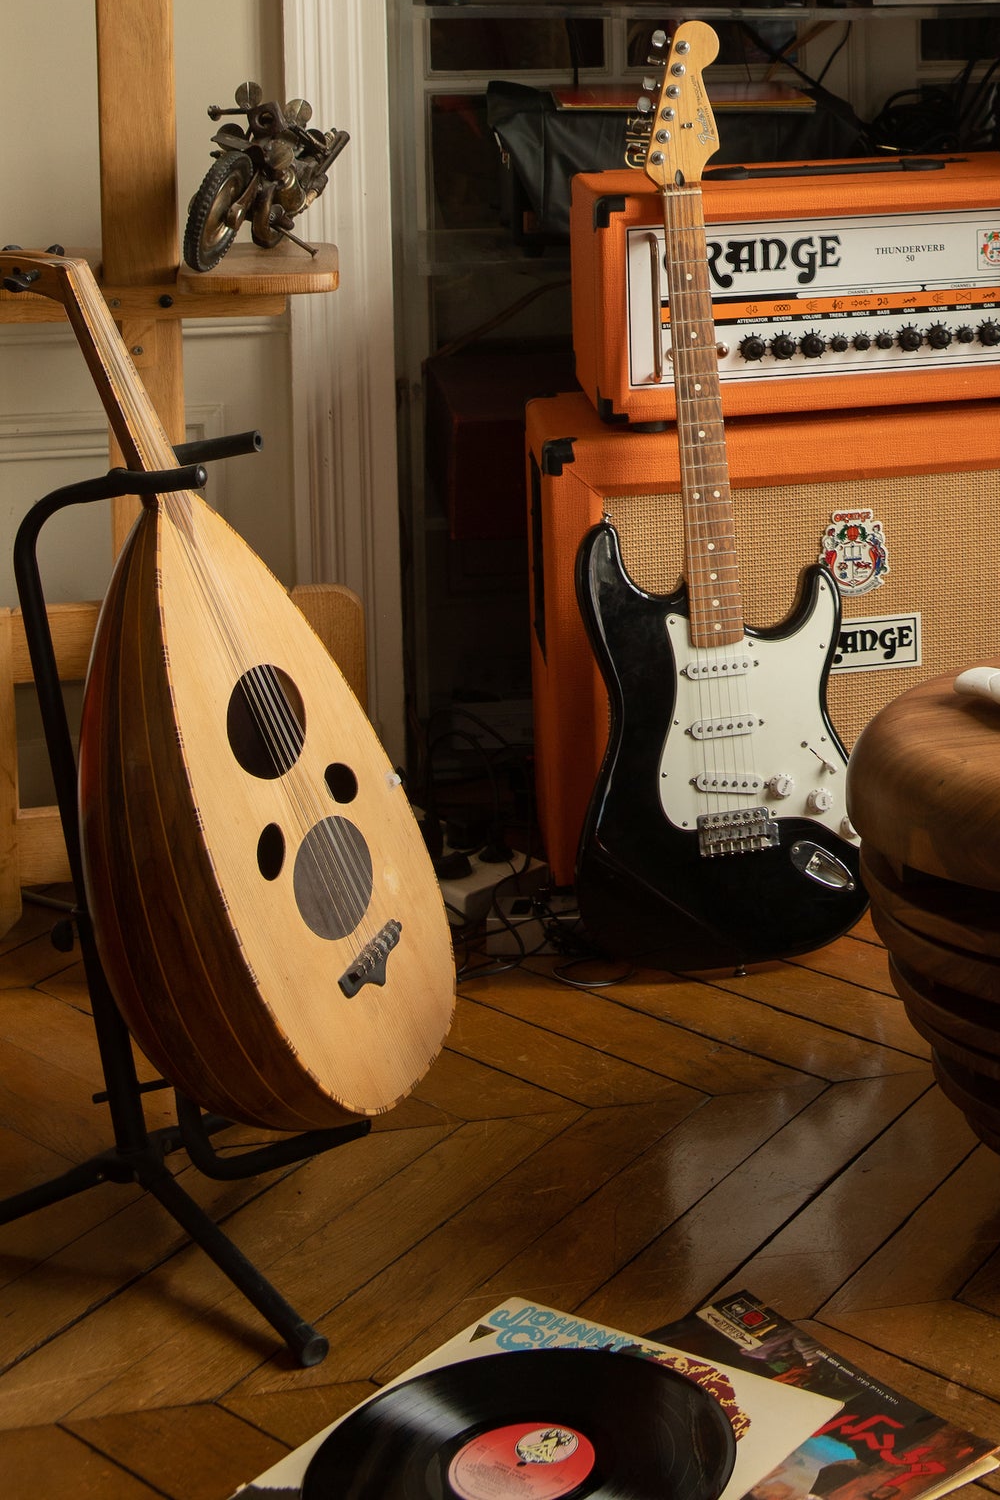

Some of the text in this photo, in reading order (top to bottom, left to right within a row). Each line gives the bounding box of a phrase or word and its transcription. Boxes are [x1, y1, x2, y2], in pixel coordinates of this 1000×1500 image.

[695, 108, 716, 145] Fender
[663, 236, 842, 288] RANGE
[875, 243, 945, 255] THUNDERVERB
[736, 316, 768, 324] ATTENUATOR
[833, 626, 913, 664] ANGE
[488, 1306, 634, 1352] JOHNNY
[719, 1319, 746, 1339] STEREO
